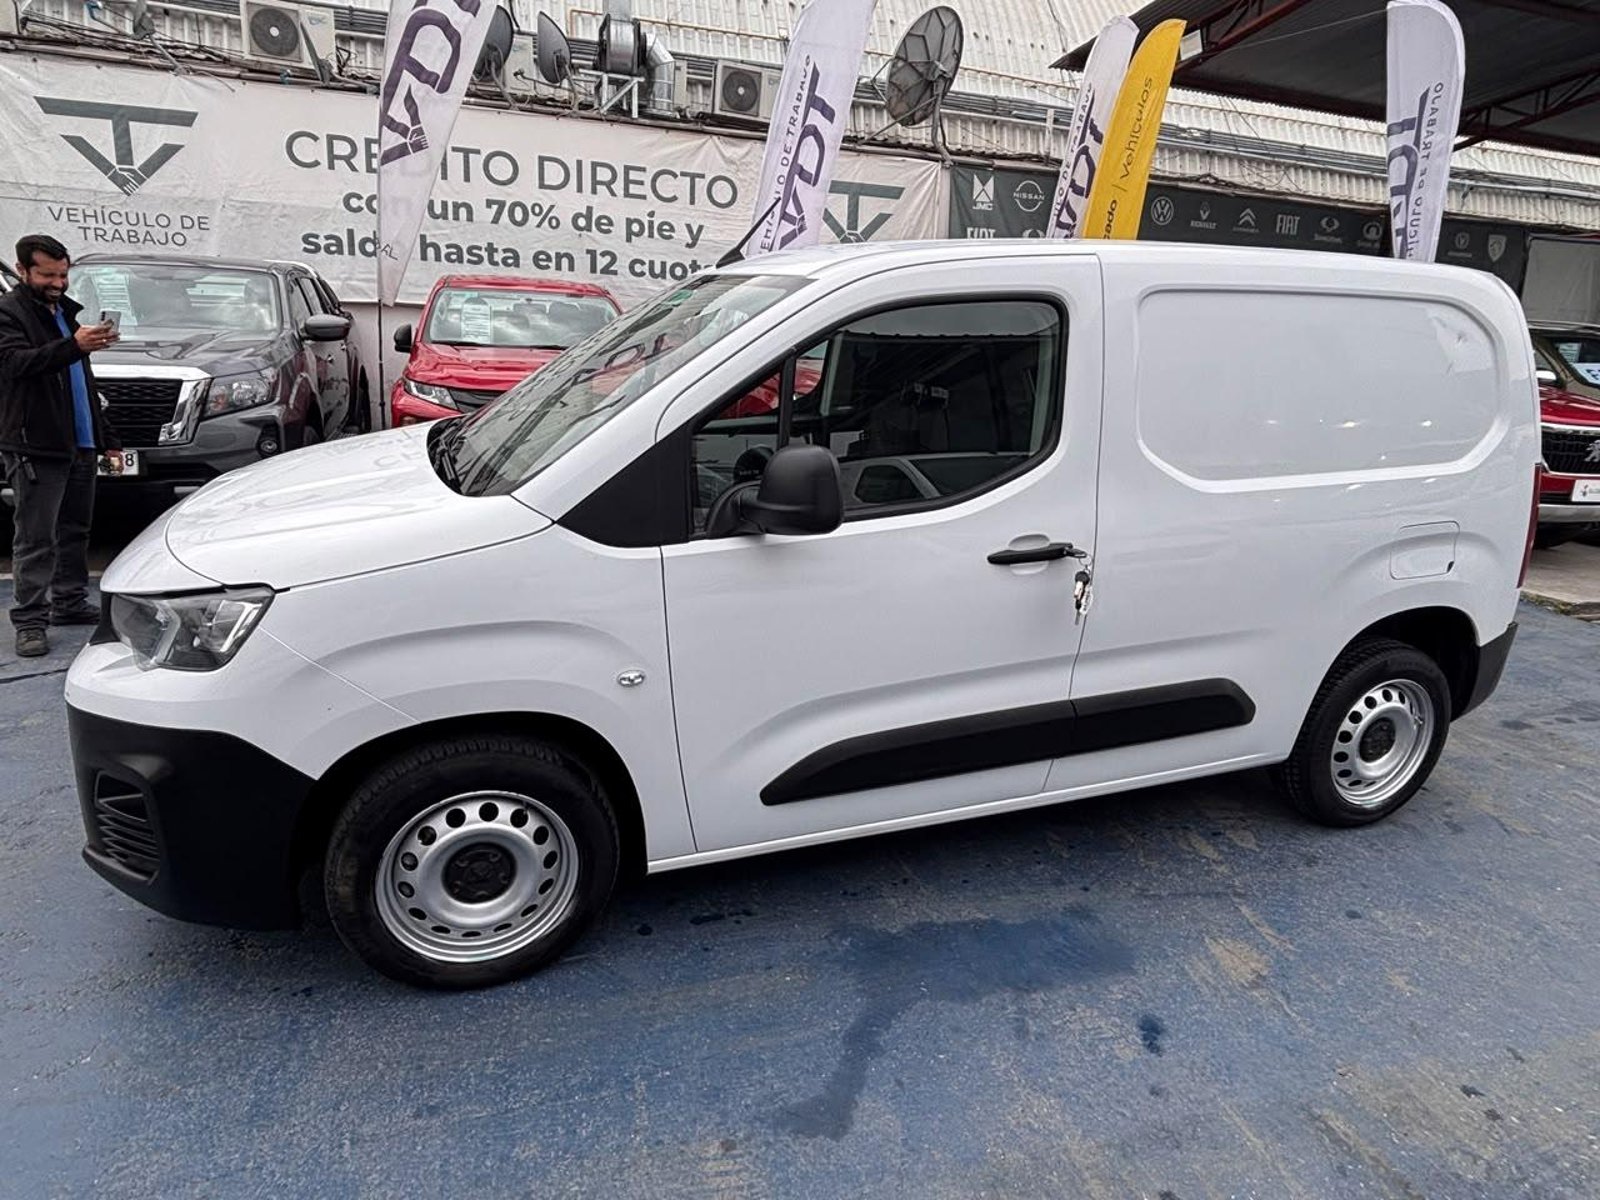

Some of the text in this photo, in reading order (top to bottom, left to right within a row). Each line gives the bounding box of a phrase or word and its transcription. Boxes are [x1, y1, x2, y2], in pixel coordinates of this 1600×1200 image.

[285, 130, 739, 209] CREITO DIRECTO
[972, 202, 994, 211] JMC
[1013, 192, 1045, 201] NISSAN
[47, 205, 210, 231] VEHÍCULO DE
[427, 199, 474, 223] un
[485, 198, 561, 230] 70%
[571, 205, 614, 235] de
[684, 223, 705, 249] y
[1276, 213, 1300, 235] FIAT
[78, 226, 188, 247] TRABAJO
[301, 228, 377, 258] sald
[419, 234, 521, 268] hasta
[532, 250, 575, 272] en
[586, 249, 618, 276] 12
